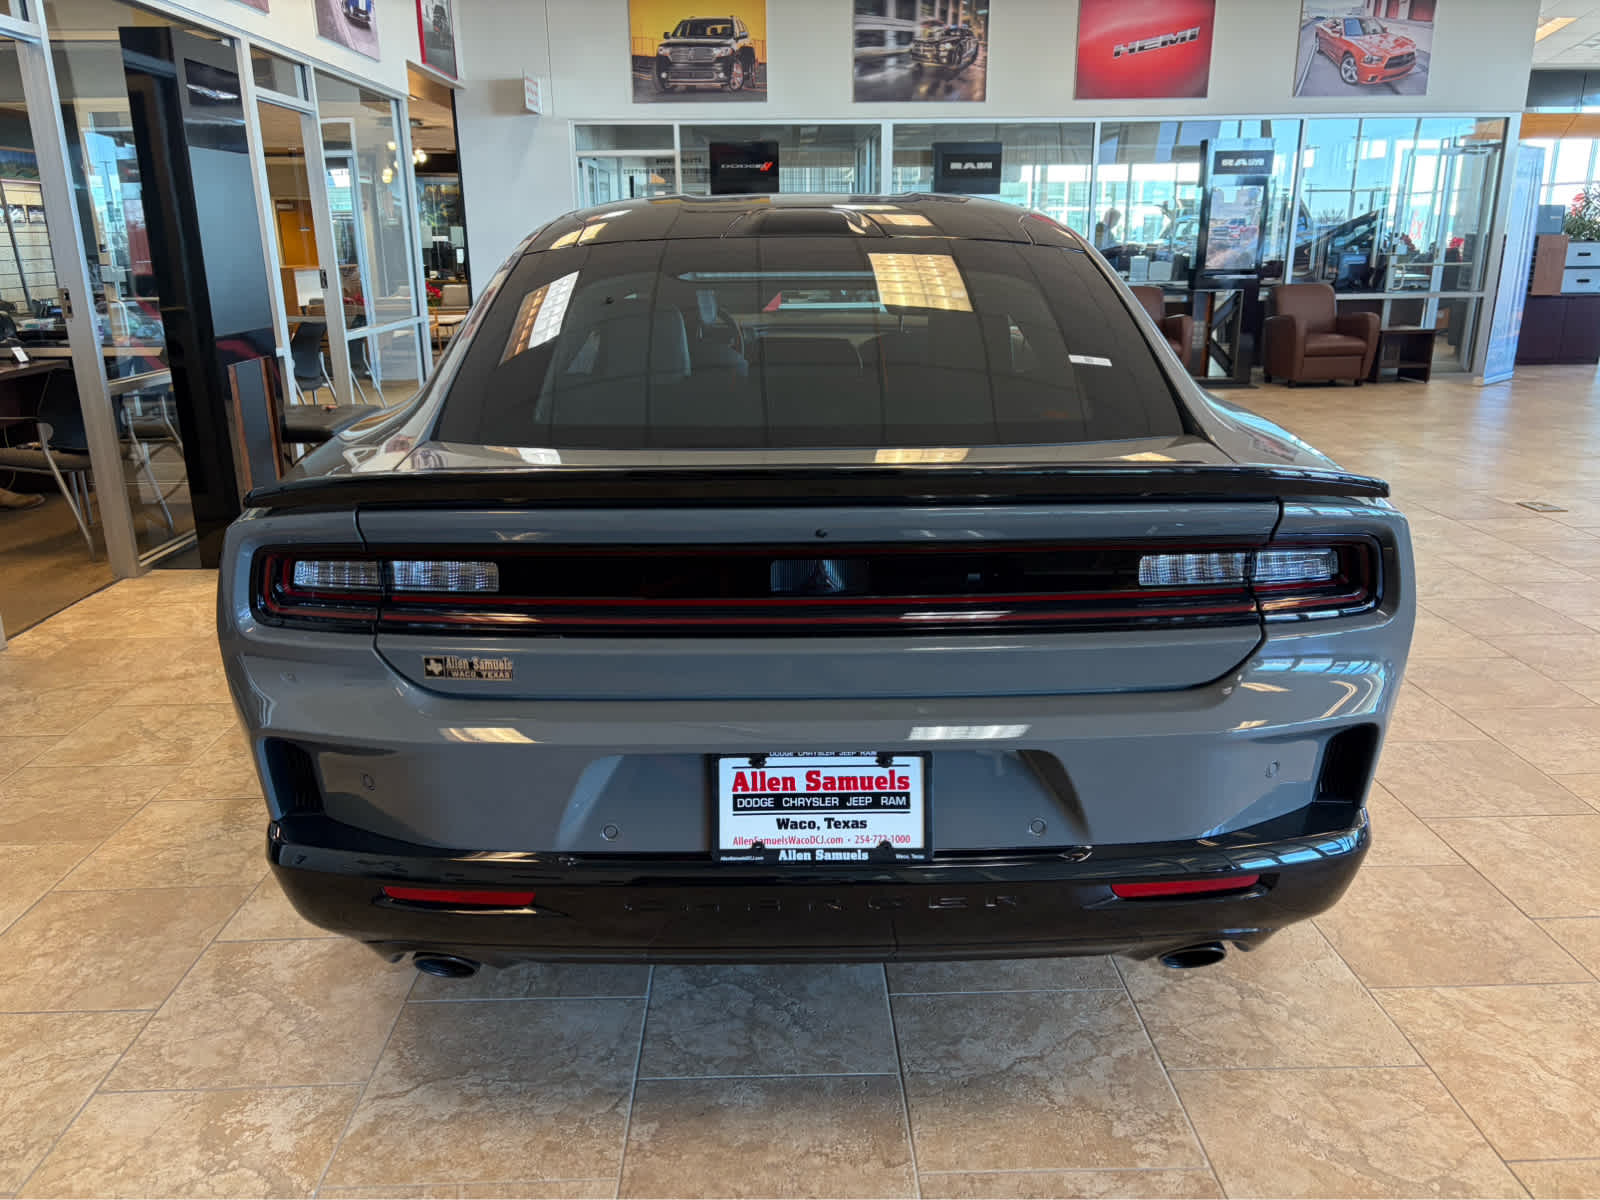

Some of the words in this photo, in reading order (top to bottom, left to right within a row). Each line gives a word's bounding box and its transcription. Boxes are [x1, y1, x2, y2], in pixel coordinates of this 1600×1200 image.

[1113, 27, 1200, 59] HEMI
[1221, 158, 1265, 167] RAM
[445, 655, 470, 669] Allen
[472, 656, 512, 670] Samuels
[482, 671, 511, 679] TEXAS
[732, 771, 797, 792] Allen
[805, 770, 911, 791] Samuels
[737, 798, 774, 808] DODGE
[782, 798, 839, 807] CHRYSLER
[846, 797, 872, 806] JEEP
[880, 796, 906, 806] RAM
[776, 818, 820, 831] Waco,
[824, 817, 868, 829] Texas
[778, 849, 811, 861] Allen
[815, 849, 869, 861] Samuels
